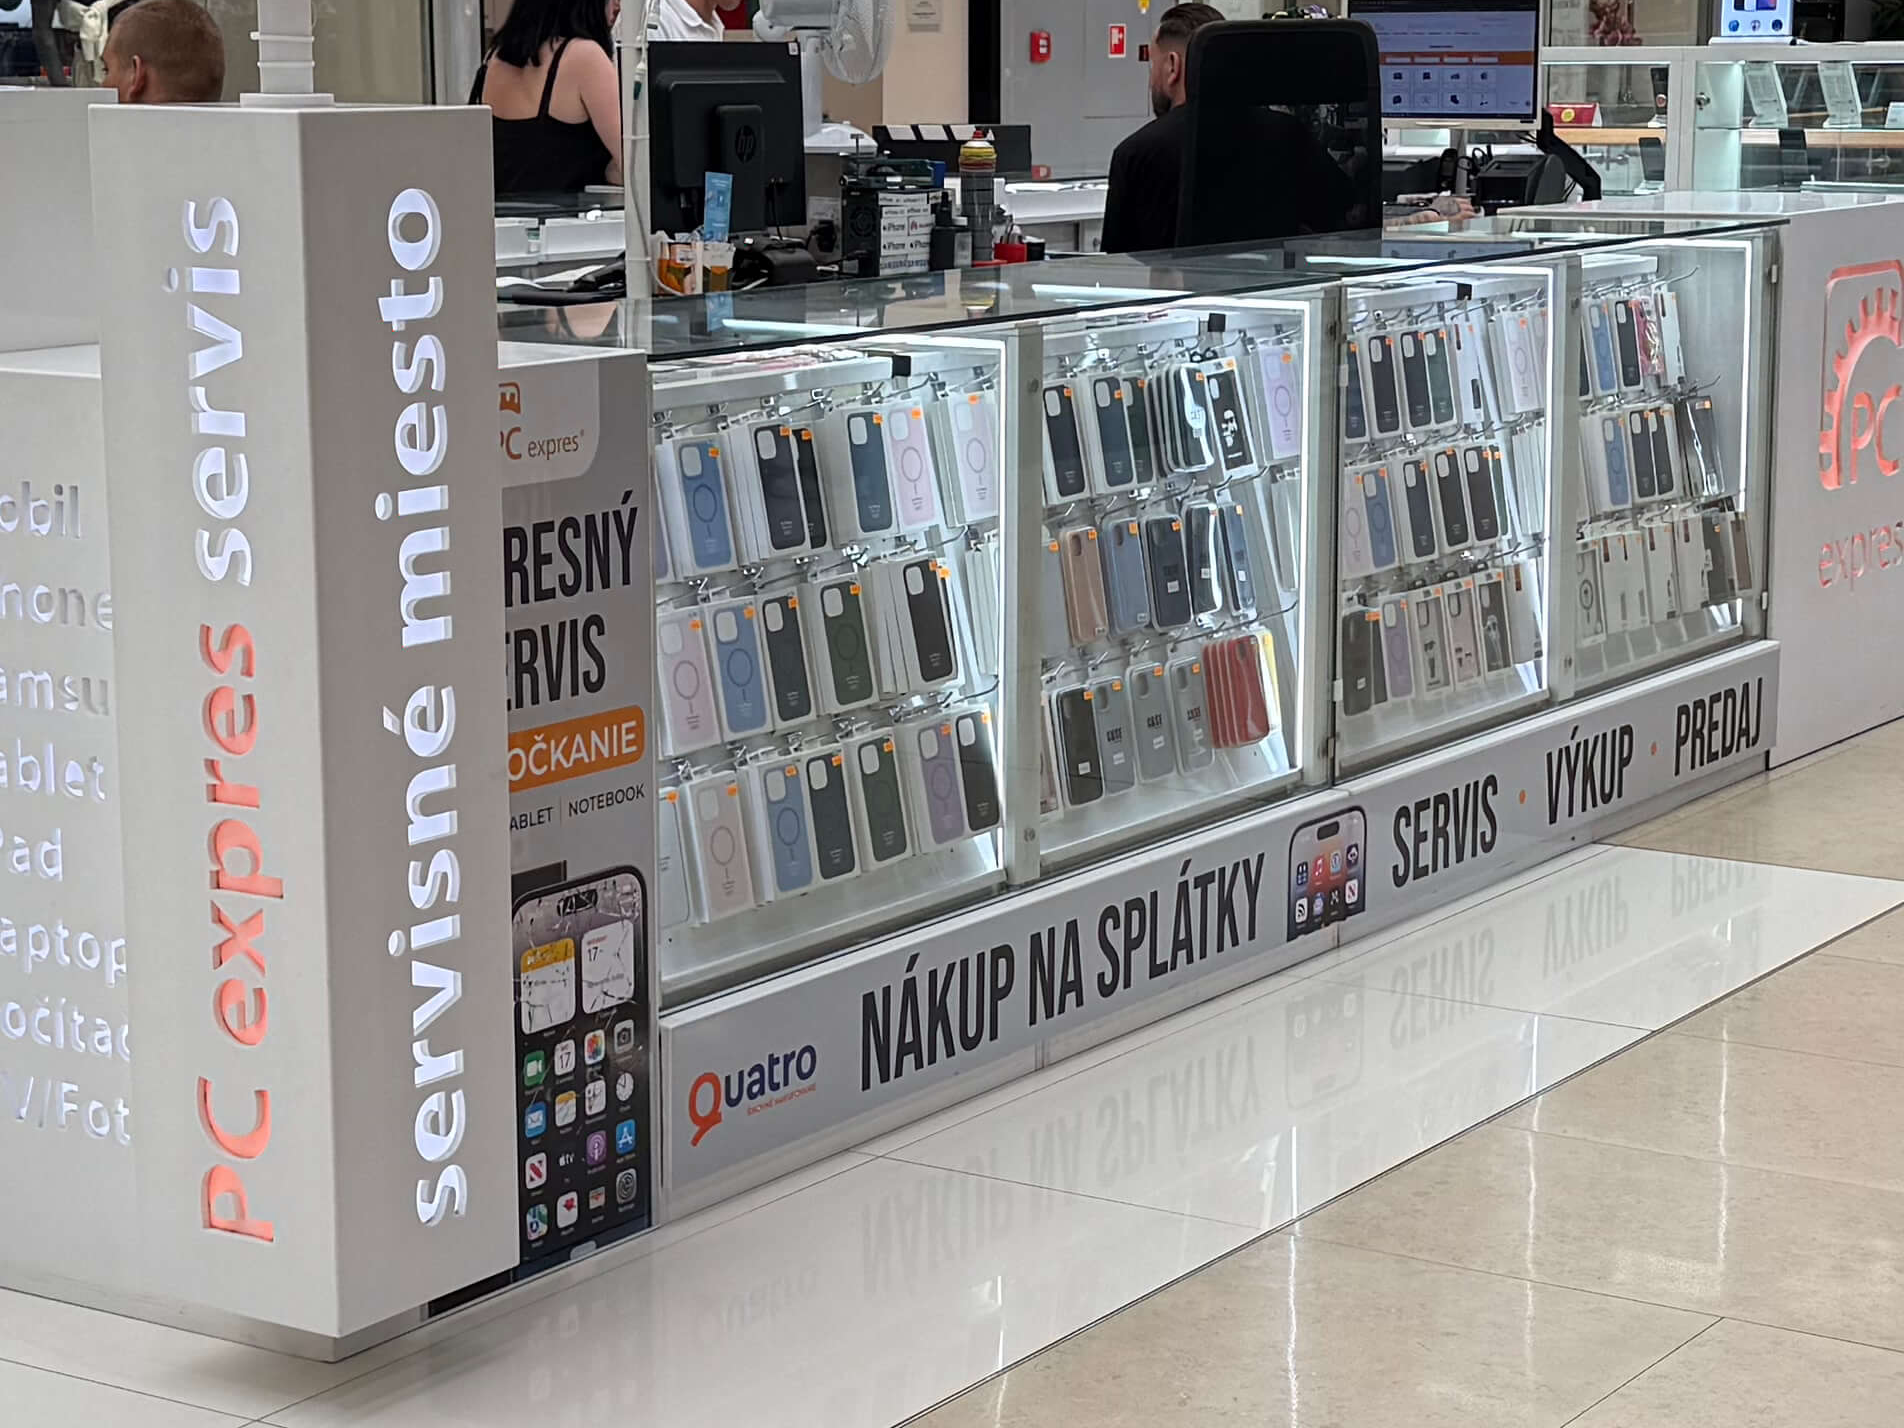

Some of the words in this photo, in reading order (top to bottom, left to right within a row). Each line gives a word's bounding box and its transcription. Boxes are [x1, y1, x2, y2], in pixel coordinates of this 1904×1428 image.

[162, 196, 254, 588] servis
[375, 187, 454, 648] miesto
[500, 426, 522, 460] C
[527, 434, 579, 461] expres
[1851, 383, 1903, 485] PC
[504, 490, 639, 608] RESNÝ
[1818, 518, 1904, 594] expres
[508, 719, 639, 782] OČKANIE
[509, 806, 554, 832] ABLET
[568, 783, 645, 818] NOTEBOOK
[1392, 773, 1498, 889] SERVIS
[1545, 725, 1635, 825] VÝKUP
[1674, 677, 1763, 777] PREDAJ
[198, 622, 285, 1047] expres
[382, 684, 468, 1227] servisné
[860, 953, 1015, 1093] NÁKUP
[1028, 919, 1084, 1028] NA
[1096, 852, 1266, 999] SPLÁTKY
[199, 1075, 276, 1243] PC
[688, 1044, 817, 1148] Quatro
